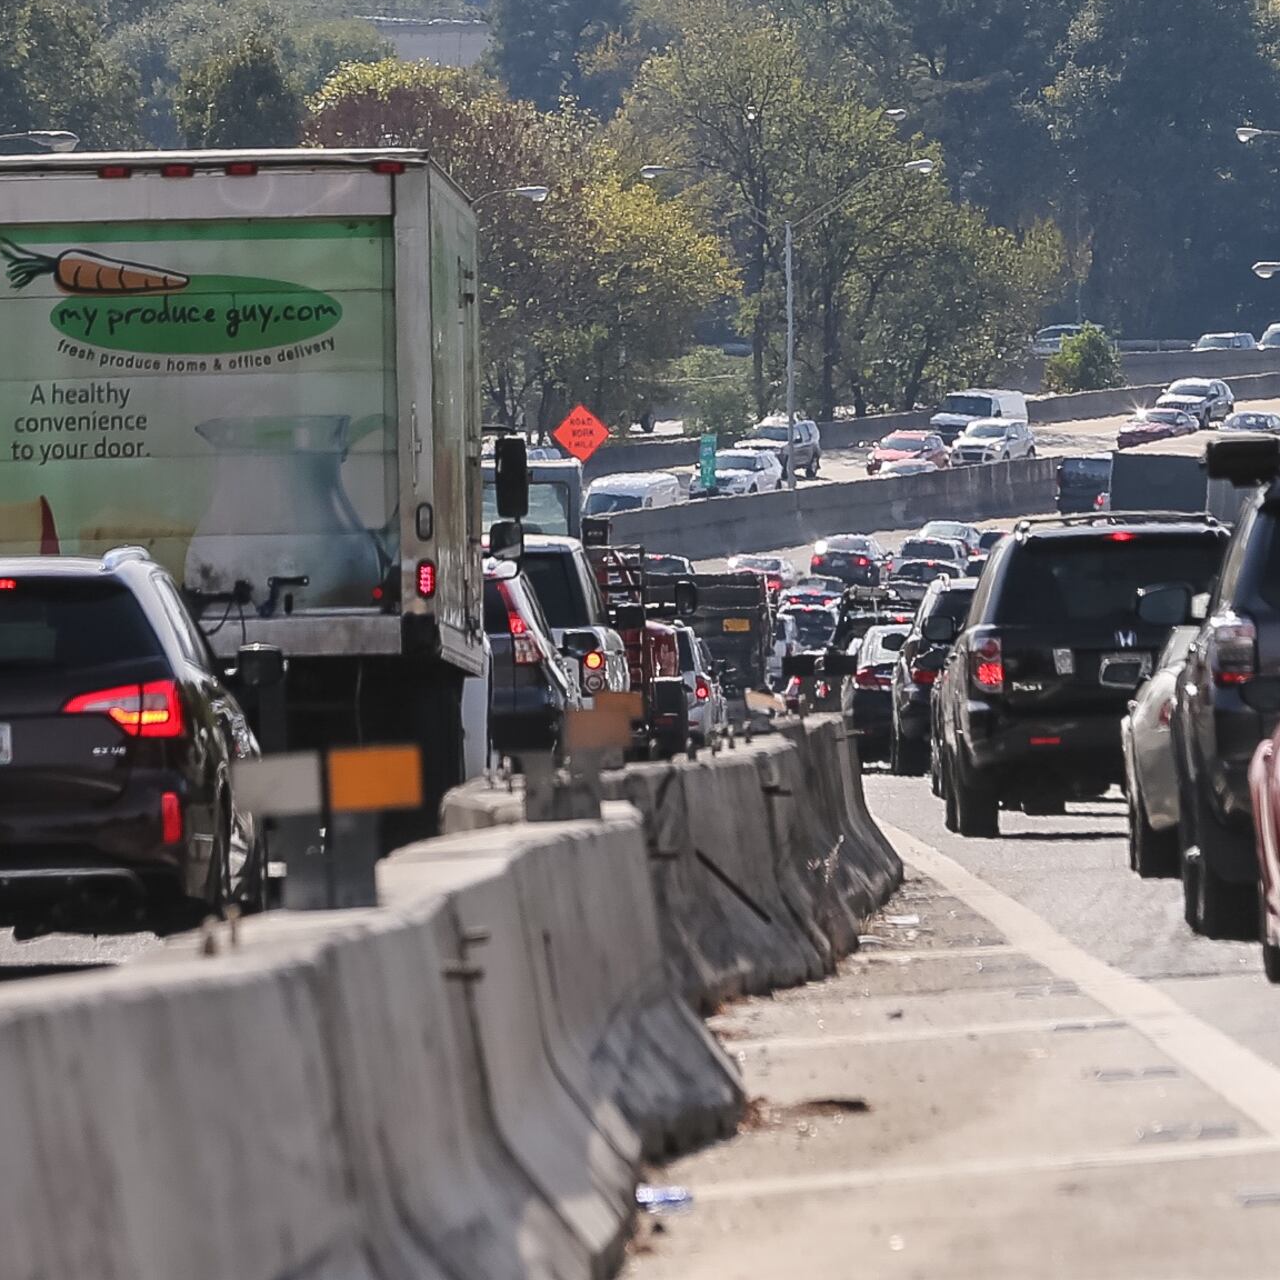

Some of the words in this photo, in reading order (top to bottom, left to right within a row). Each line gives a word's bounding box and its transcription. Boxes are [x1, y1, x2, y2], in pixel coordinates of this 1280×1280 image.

[58, 306, 98, 336] my
[107, 293, 216, 335] produce
[226, 304, 337, 338] guy.com
[57, 339, 95, 361] fresh
[99, 353, 160, 368] produce
[166, 358, 207, 372] home
[213, 358, 222, 371] &
[229, 354, 271, 370] office
[277, 337, 335, 363] delivery
[30, 384, 45, 404] A
[52, 382, 130, 409] healthy
[14, 410, 147, 433] convenience
[570, 418, 593, 426] ROAD
[572, 428, 594, 438] WORK
[11, 440, 34, 460] to
[40, 442, 88, 465] your
[94, 436, 151, 459] door.
